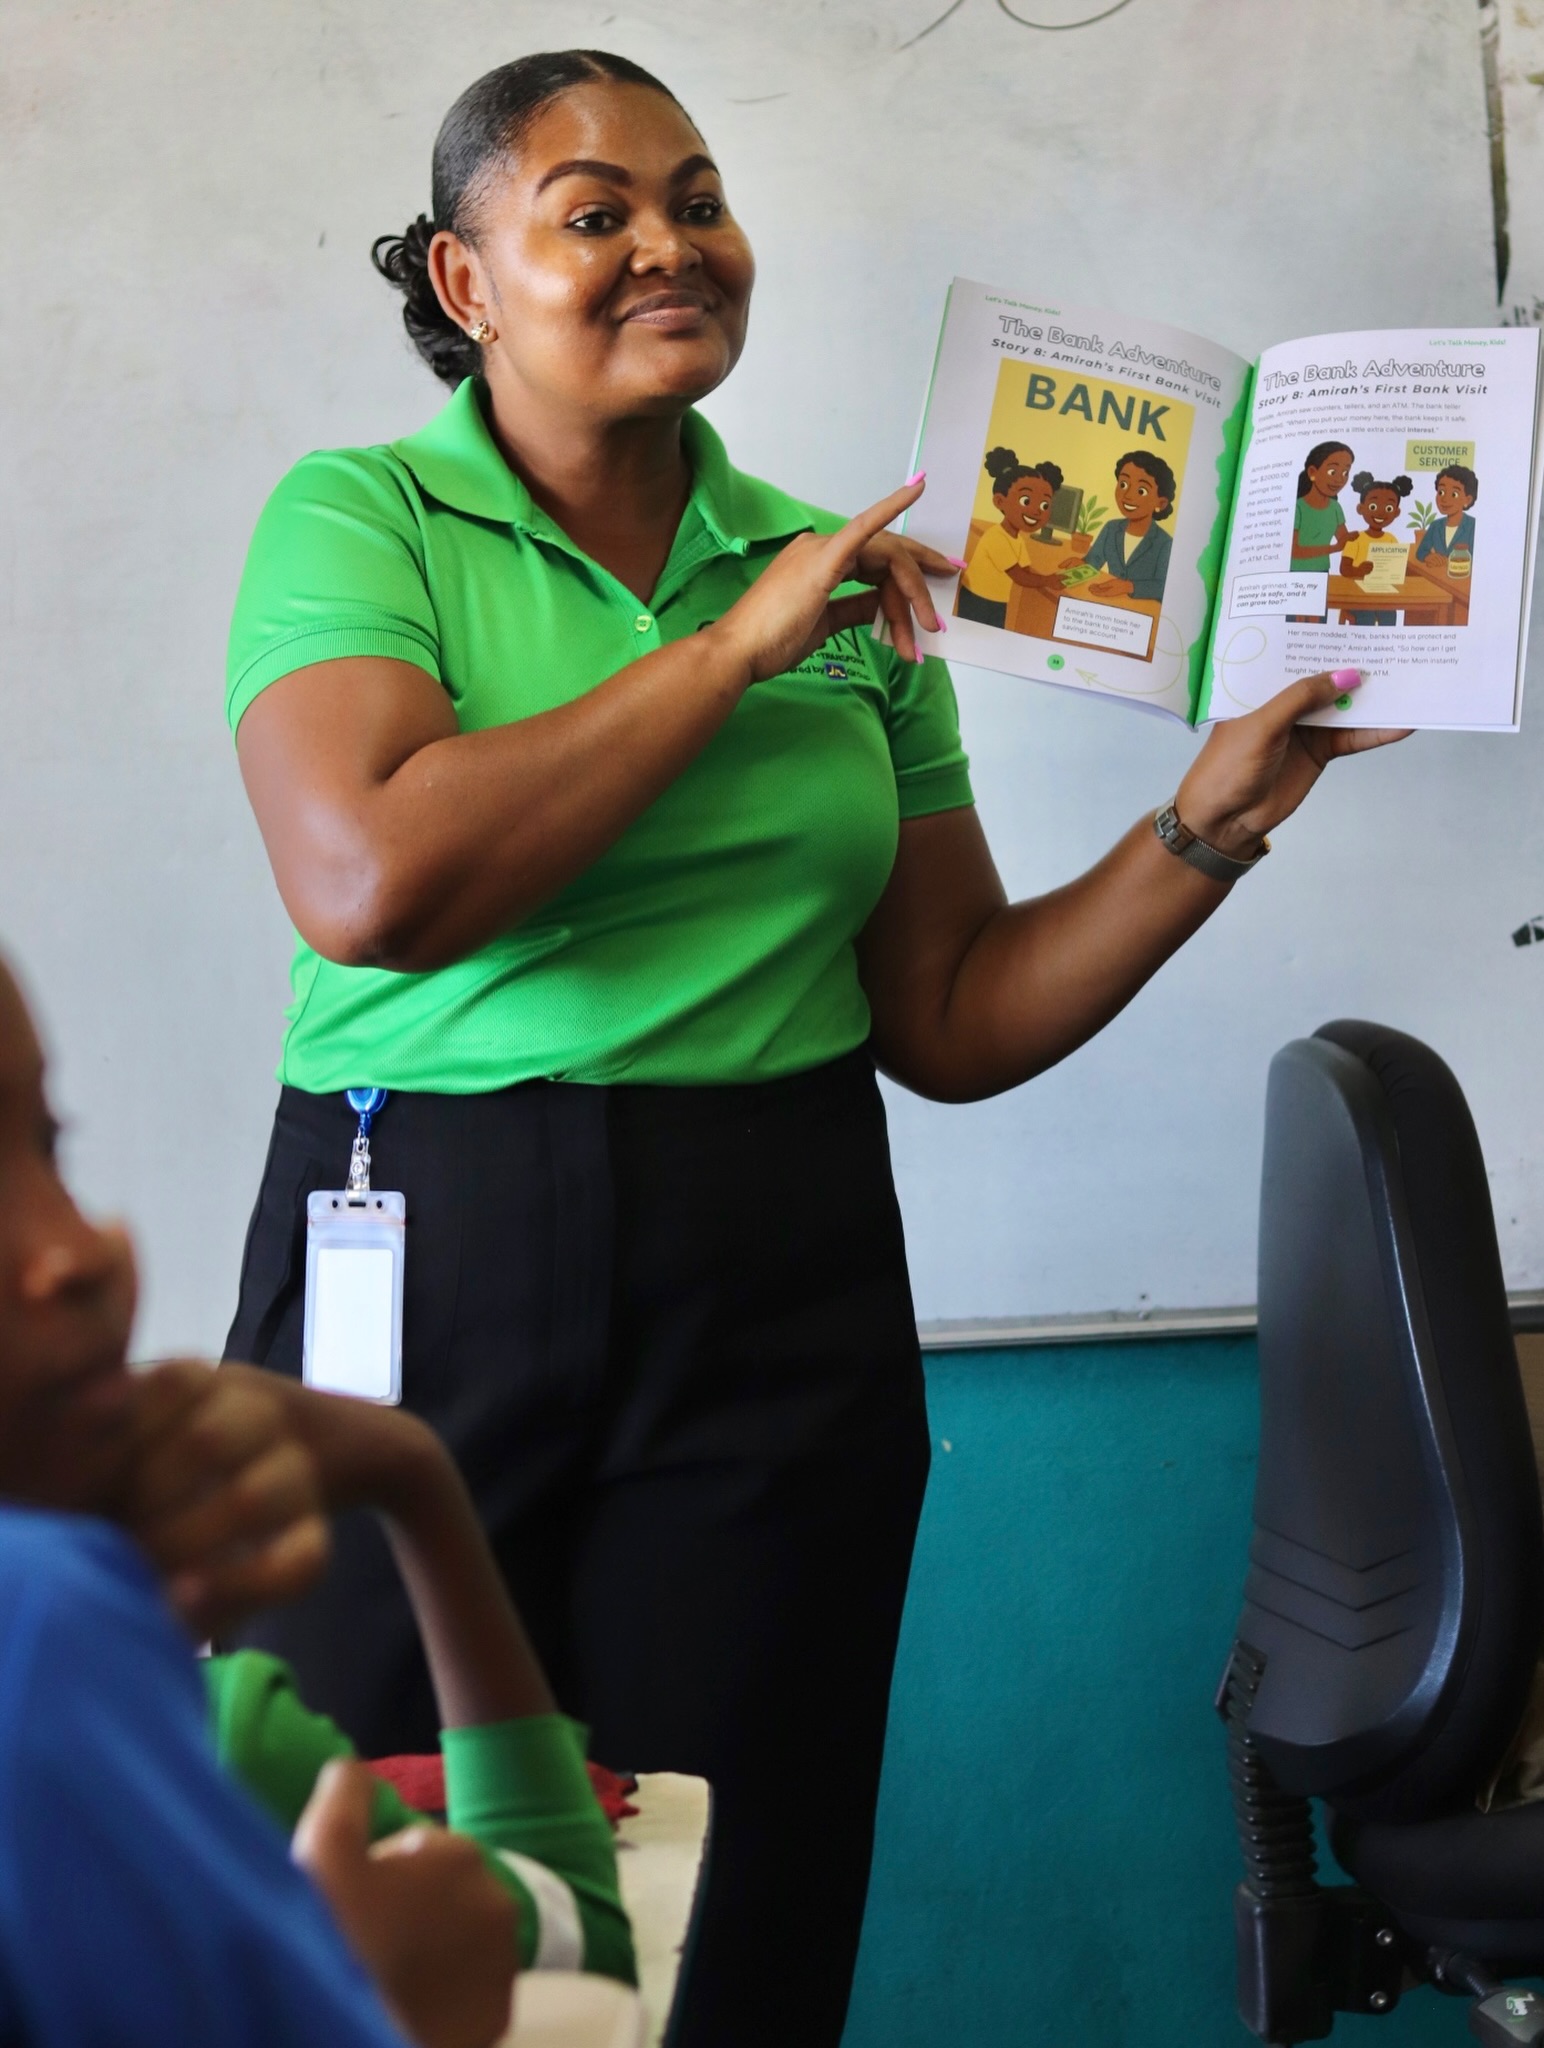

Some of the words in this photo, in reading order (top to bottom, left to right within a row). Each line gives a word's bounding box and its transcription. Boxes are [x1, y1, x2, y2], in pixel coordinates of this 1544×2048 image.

[1004, 299, 1017, 307] Talk
[999, 315, 1043, 340] The
[1047, 325, 1104, 354] Bank
[1108, 341, 1221, 392] Adventure
[991, 338, 1030, 355] Story
[1033, 347, 1047, 357] 8:
[1050, 351, 1114, 373] Amirah's
[1119, 366, 1151, 382] First
[1155, 376, 1191, 394] Bank
[1195, 389, 1222, 409] Visit
[1264, 371, 1299, 391] The
[1304, 360, 1357, 383] Bank
[1362, 358, 1485, 378] Adventure
[1258, 394, 1288, 410] Story
[1292, 391, 1304, 400] 8:
[1307, 385, 1369, 398] Amirah's
[1375, 384, 1407, 394] First
[1413, 384, 1450, 394] Bank
[1456, 384, 1488, 395] Visit
[1025, 373, 1171, 442] BANK
[1277, 408, 1298, 417] Amirah
[1307, 417, 1320, 425] you
[1321, 416, 1332, 424] put
[1333, 415, 1348, 423] your
[1349, 414, 1372, 422] money
[1284, 431, 1296, 439] you
[1297, 429, 1311, 437] may
[1413, 445, 1468, 456] CUSTOMER
[1272, 460, 1293, 469] placed
[1419, 457, 1460, 467] SERVICE
[1248, 486, 1269, 496] savings
[1257, 508, 1272, 516] teller
[1273, 507, 1289, 515] gave
[1265, 530, 1281, 538] bank
[1256, 543, 1272, 551] gave
[1371, 546, 1407, 554] APPLICATION
[1247, 554, 1262, 563] ATM
[1238, 583, 1260, 592] Amirah
[1065, 607, 1094, 619] Amirah's
[1095, 613, 1112, 623] mom
[1113, 617, 1128, 626] took
[1129, 621, 1141, 629] her
[1072, 616, 1083, 625] the
[1084, 619, 1101, 628] bank
[1102, 622, 1110, 630] to
[1111, 625, 1129, 634] open
[1062, 623, 1087, 635] savings
[1089, 629, 1118, 640] account.
[1286, 642, 1304, 650] grow
[1445, 645, 1457, 653] get
[1298, 655, 1322, 664] money
[1430, 657, 1459, 665] instantly
[812, 665, 825, 675] by
[1284, 667, 1307, 675] taught
